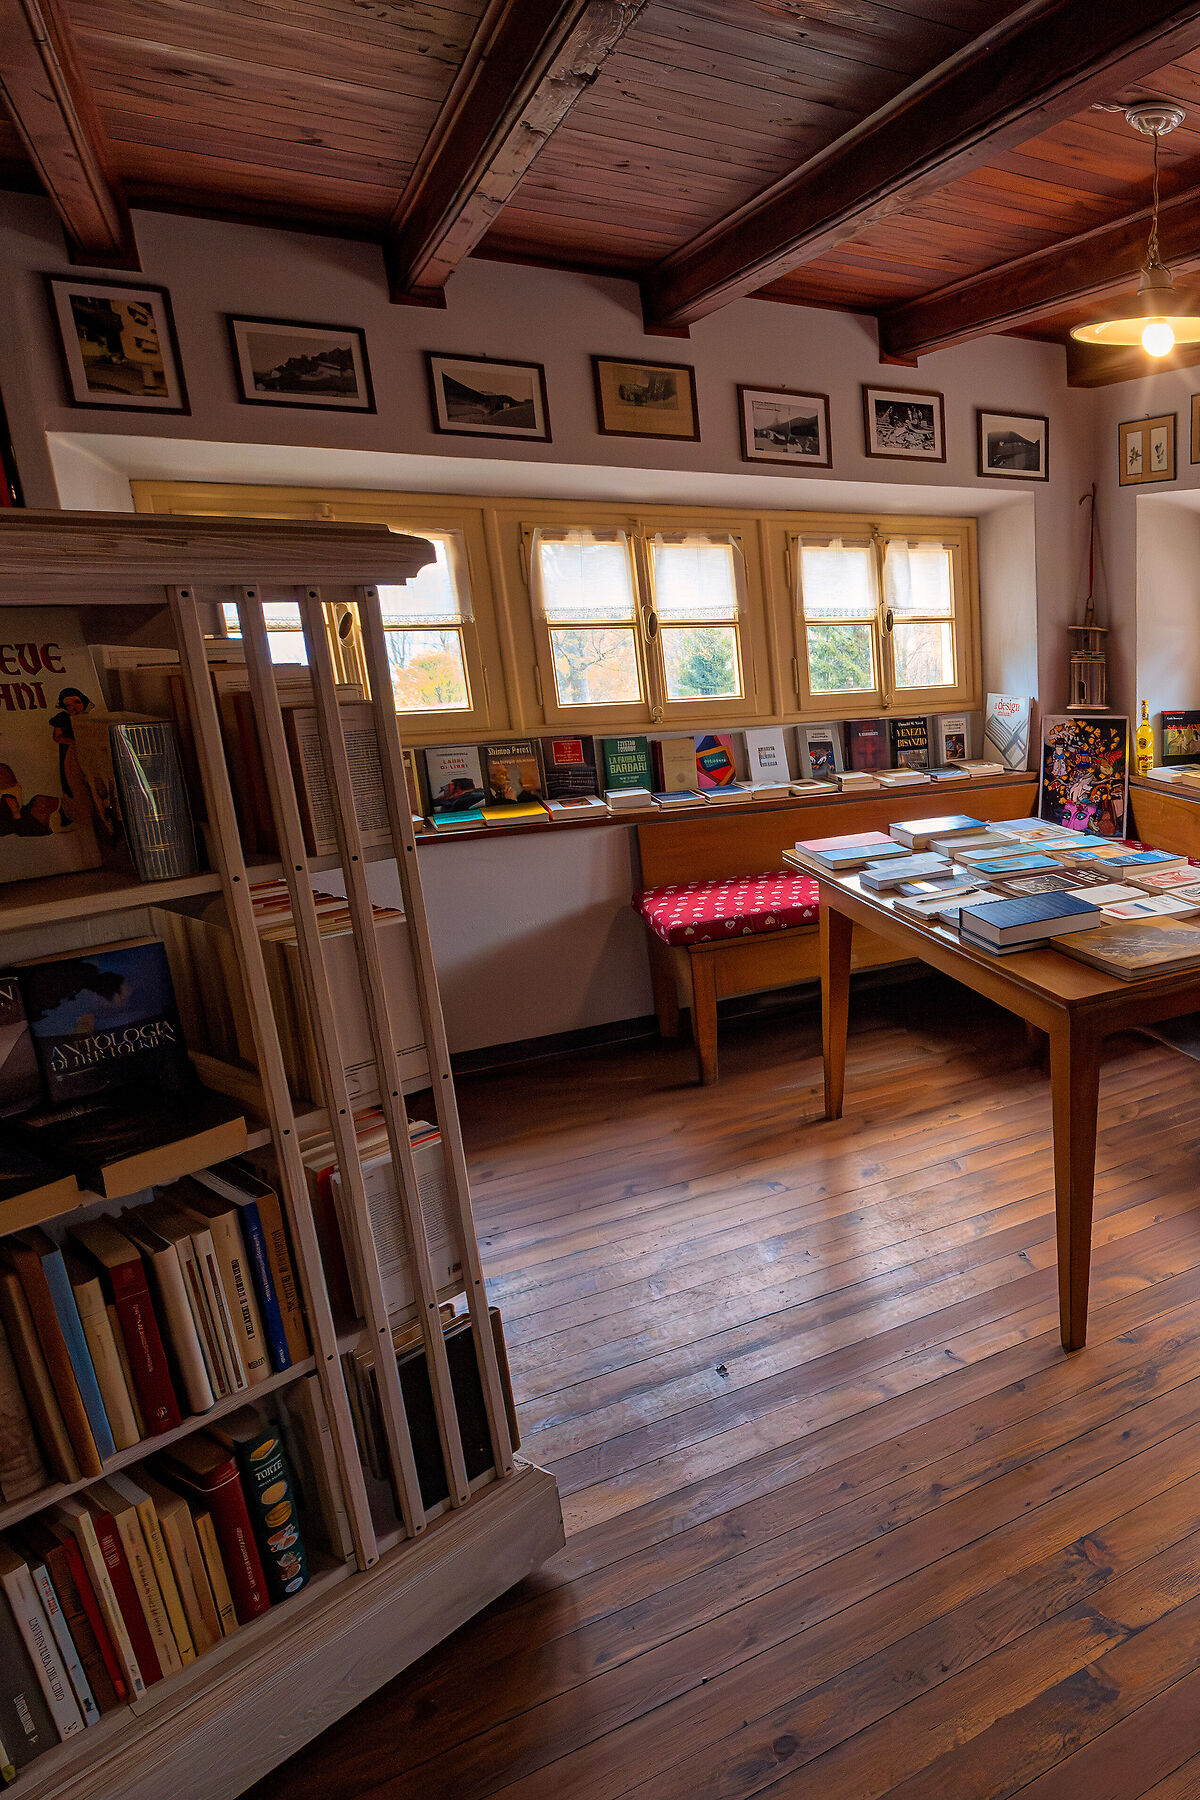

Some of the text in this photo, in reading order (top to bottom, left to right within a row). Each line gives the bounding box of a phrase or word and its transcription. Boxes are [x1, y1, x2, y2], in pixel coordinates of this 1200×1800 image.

[998, 698, 1020, 714] design
[896, 727, 927, 737] VENEZIA
[897, 738, 928, 748] BISANZIO
[487, 748, 511, 756] Shimon
[610, 762, 647, 774] BARBARI
[52, 1020, 176, 1060] ANTOLOGIA
[255, 1459, 283, 1481] TORTE
[27, 1616, 53, 1666] L'AVVENTURA
[45, 1665, 60, 1682] DEL
